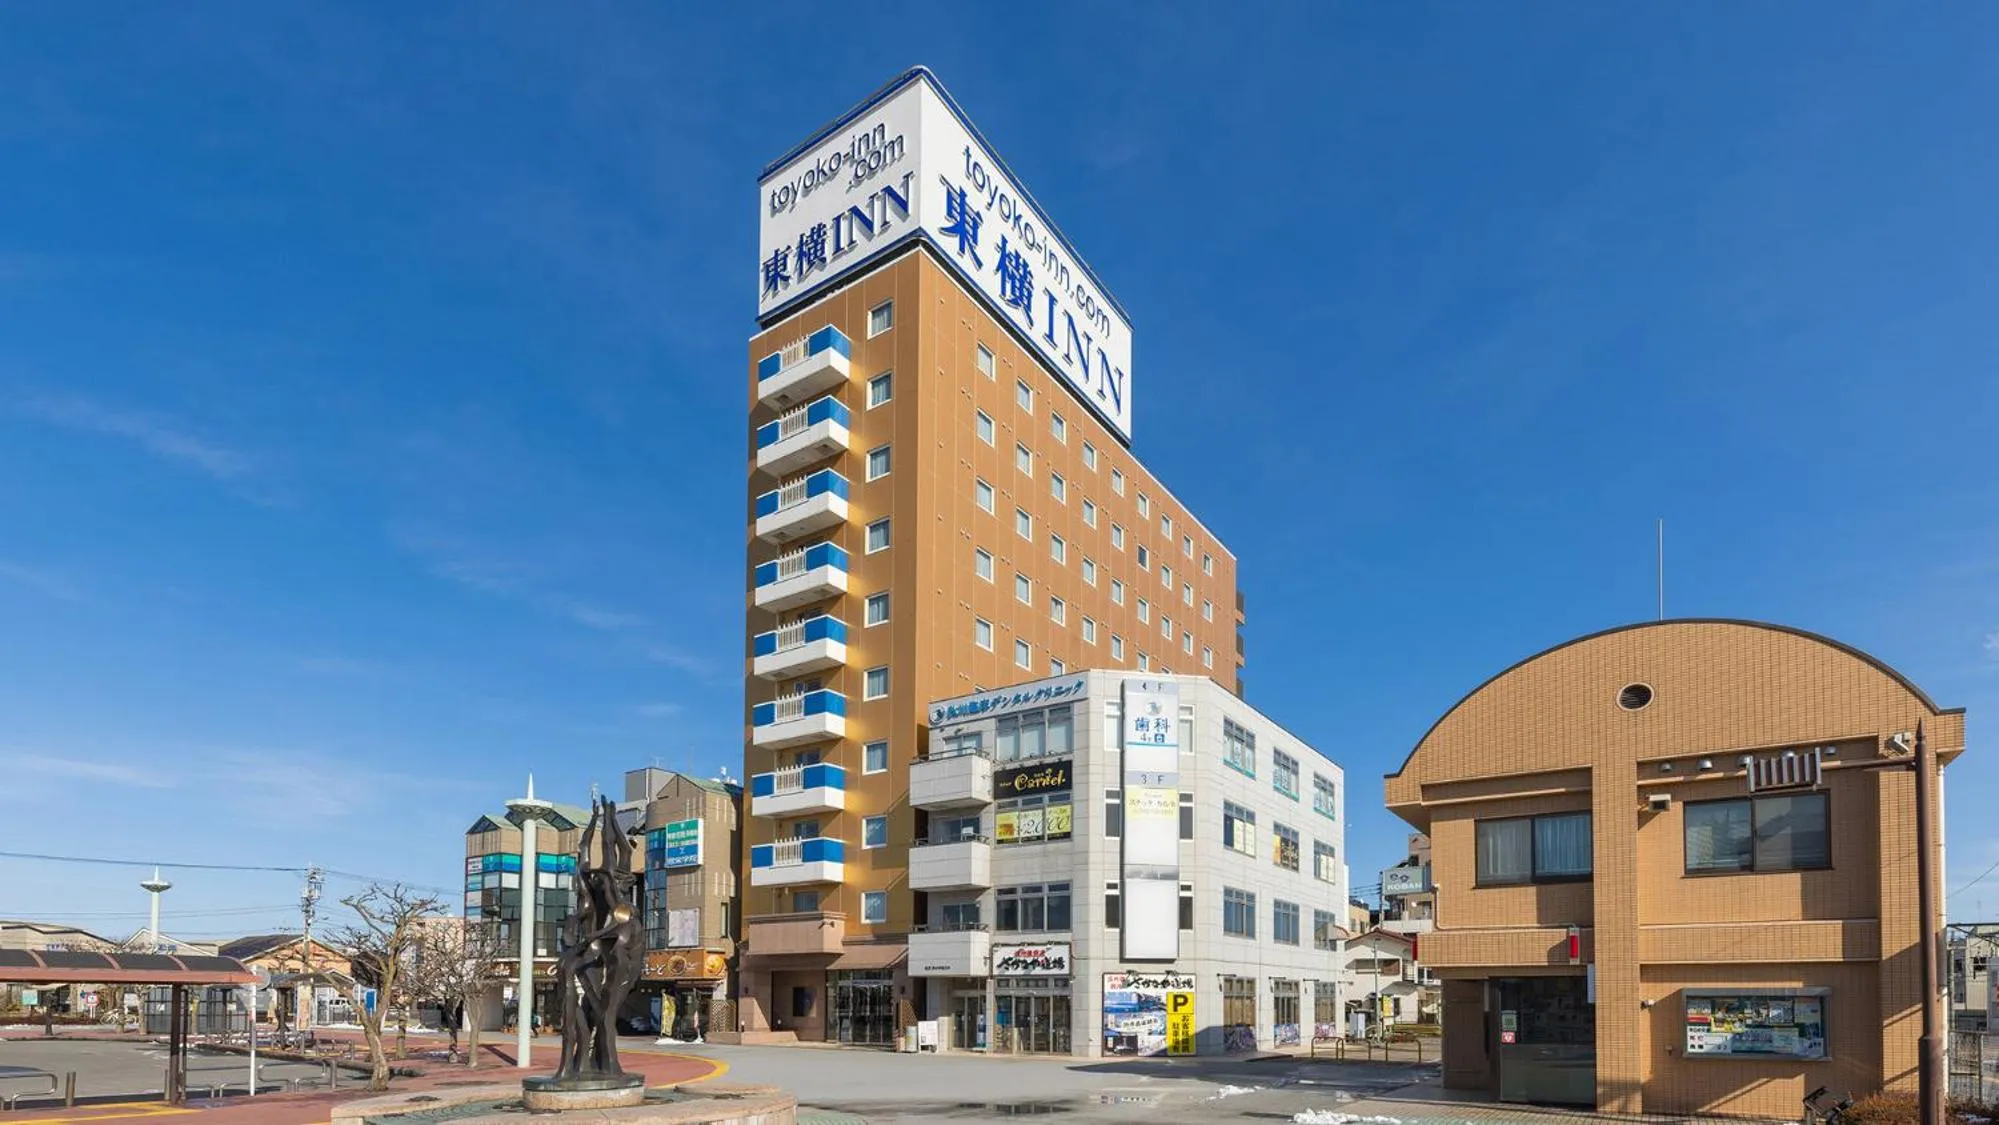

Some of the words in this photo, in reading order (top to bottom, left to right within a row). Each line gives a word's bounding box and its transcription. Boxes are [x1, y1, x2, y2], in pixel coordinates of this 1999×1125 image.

[769, 121, 886, 213] toyoko-inn
[963, 144, 1111, 339] toyoko-inn.com
[1173, 994, 1189, 1012] P
